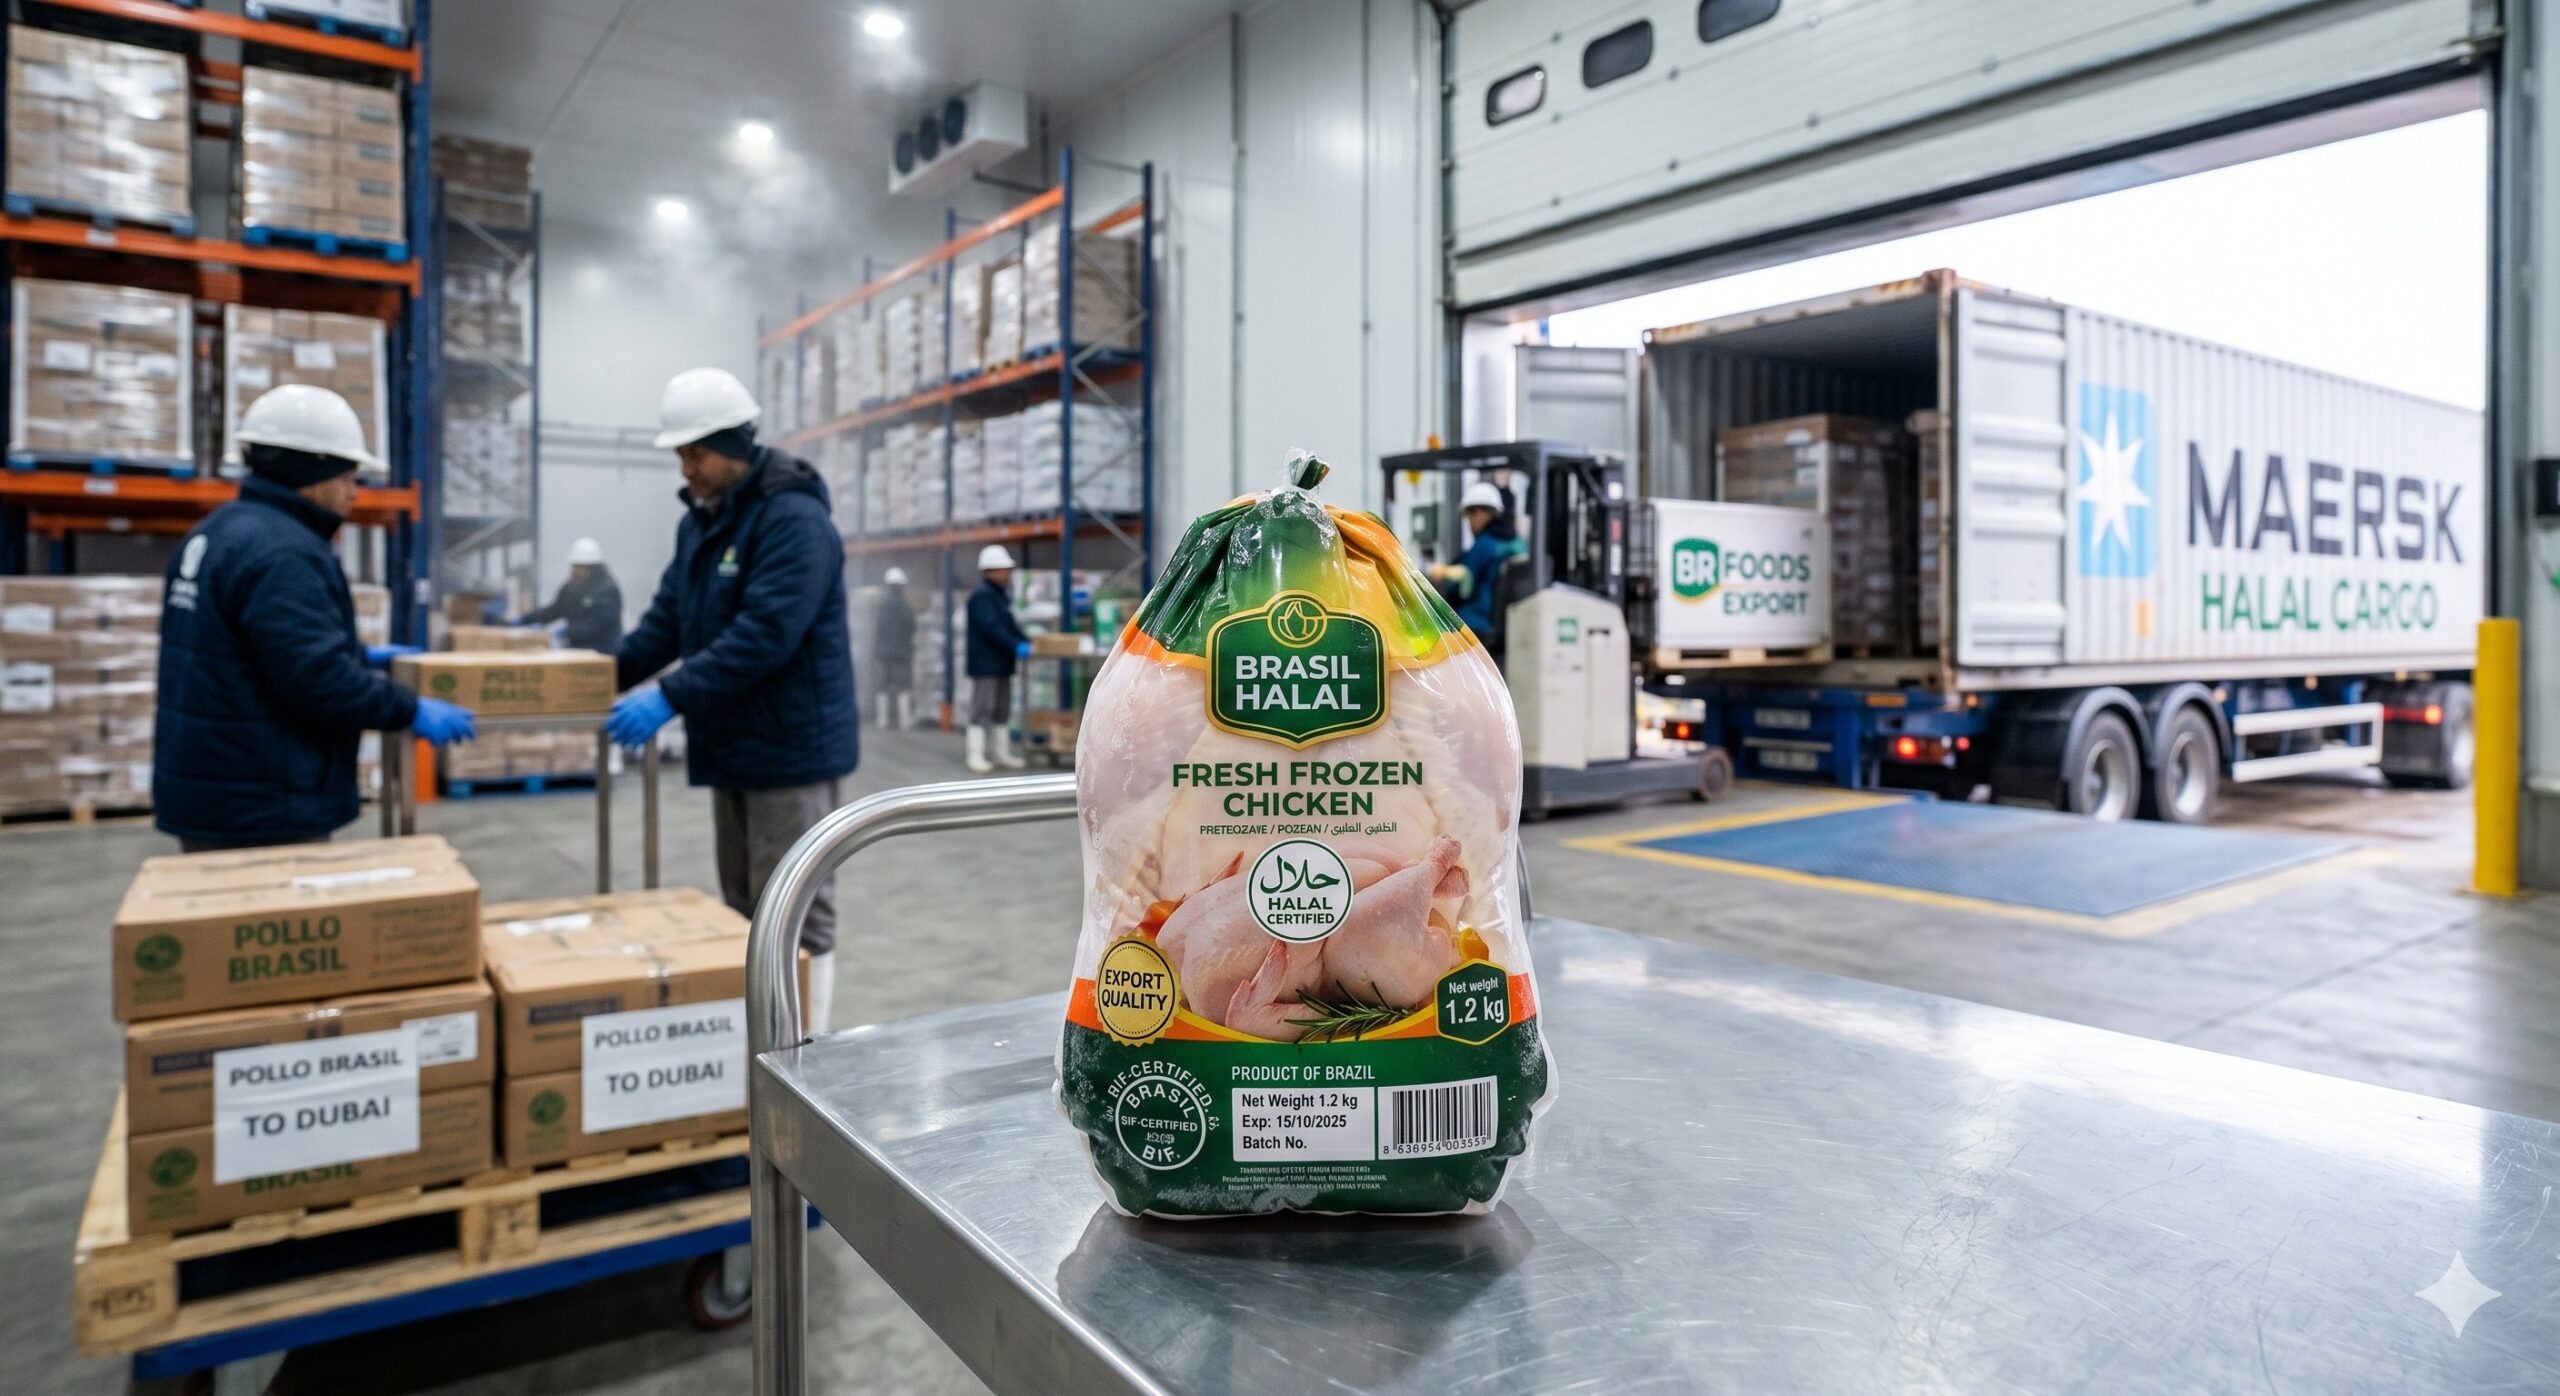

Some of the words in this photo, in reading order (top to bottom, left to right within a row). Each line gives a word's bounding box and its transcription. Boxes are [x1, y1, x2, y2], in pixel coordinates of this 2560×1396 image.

[2187, 439, 2463, 564] MAERSK
[1675, 549, 1716, 586] BR
[1724, 552, 1811, 582] FOODS
[1723, 591, 1808, 616] EXPORT
[2201, 572, 2321, 631] HALAL
[2331, 578, 2438, 630] CARGO
[1235, 655, 1361, 680] BRASIL
[1235, 684, 1361, 711] HALAL
[1172, 761, 1279, 787] FRESH
[1289, 761, 1423, 786] FROZEN
[1223, 791, 1374, 817] CHICKEN
[1278, 823, 1322, 834] POZEAN
[1260, 854, 1341, 894] حلال
[1268, 897, 1333, 910] HALAL
[1267, 913, 1335, 925] CERTIFIED
[234, 915, 343, 950] POLLO
[228, 947, 348, 983] BRASIL
[1105, 969, 1165, 990] EXPORT
[1449, 981, 1467, 995] Net
[1101, 989, 1168, 1011] QUALITY
[1445, 997, 1478, 1025] 1.2
[1483, 995, 1505, 1024] kg
[593, 1024, 661, 1048] POLLO
[666, 1017, 733, 1039] BRASIL
[229, 1059, 311, 1087] POLLO
[319, 1047, 405, 1076] BRASIL
[606, 1071, 640, 1095] TO
[647, 1061, 724, 1089] DUBAI
[1231, 1065, 1299, 1081] PRODUCT
[1303, 1065, 1321, 1081] OF
[1326, 1065, 1375, 1080] BRAZIL
[1125, 1083, 1195, 1119] BRASIL
[1242, 1094, 1264, 1107] Net
[1268, 1093, 1314, 1111] Weight
[1319, 1093, 1338, 1107] 1.2
[1342, 1093, 1358, 1110] kg
[244, 1111, 286, 1139] TO
[295, 1096, 391, 1131] DUBAI
[1121, 1115, 1198, 1132] SIF-CERTIFIED
[1242, 1114, 1271, 1131] Exp:
[1276, 1114, 1347, 1129] 15/10/2025
[1243, 1135, 1281, 1149] Batch
[1285, 1135, 1307, 1149] No.
[1383, 1145, 1390, 1155] 8
